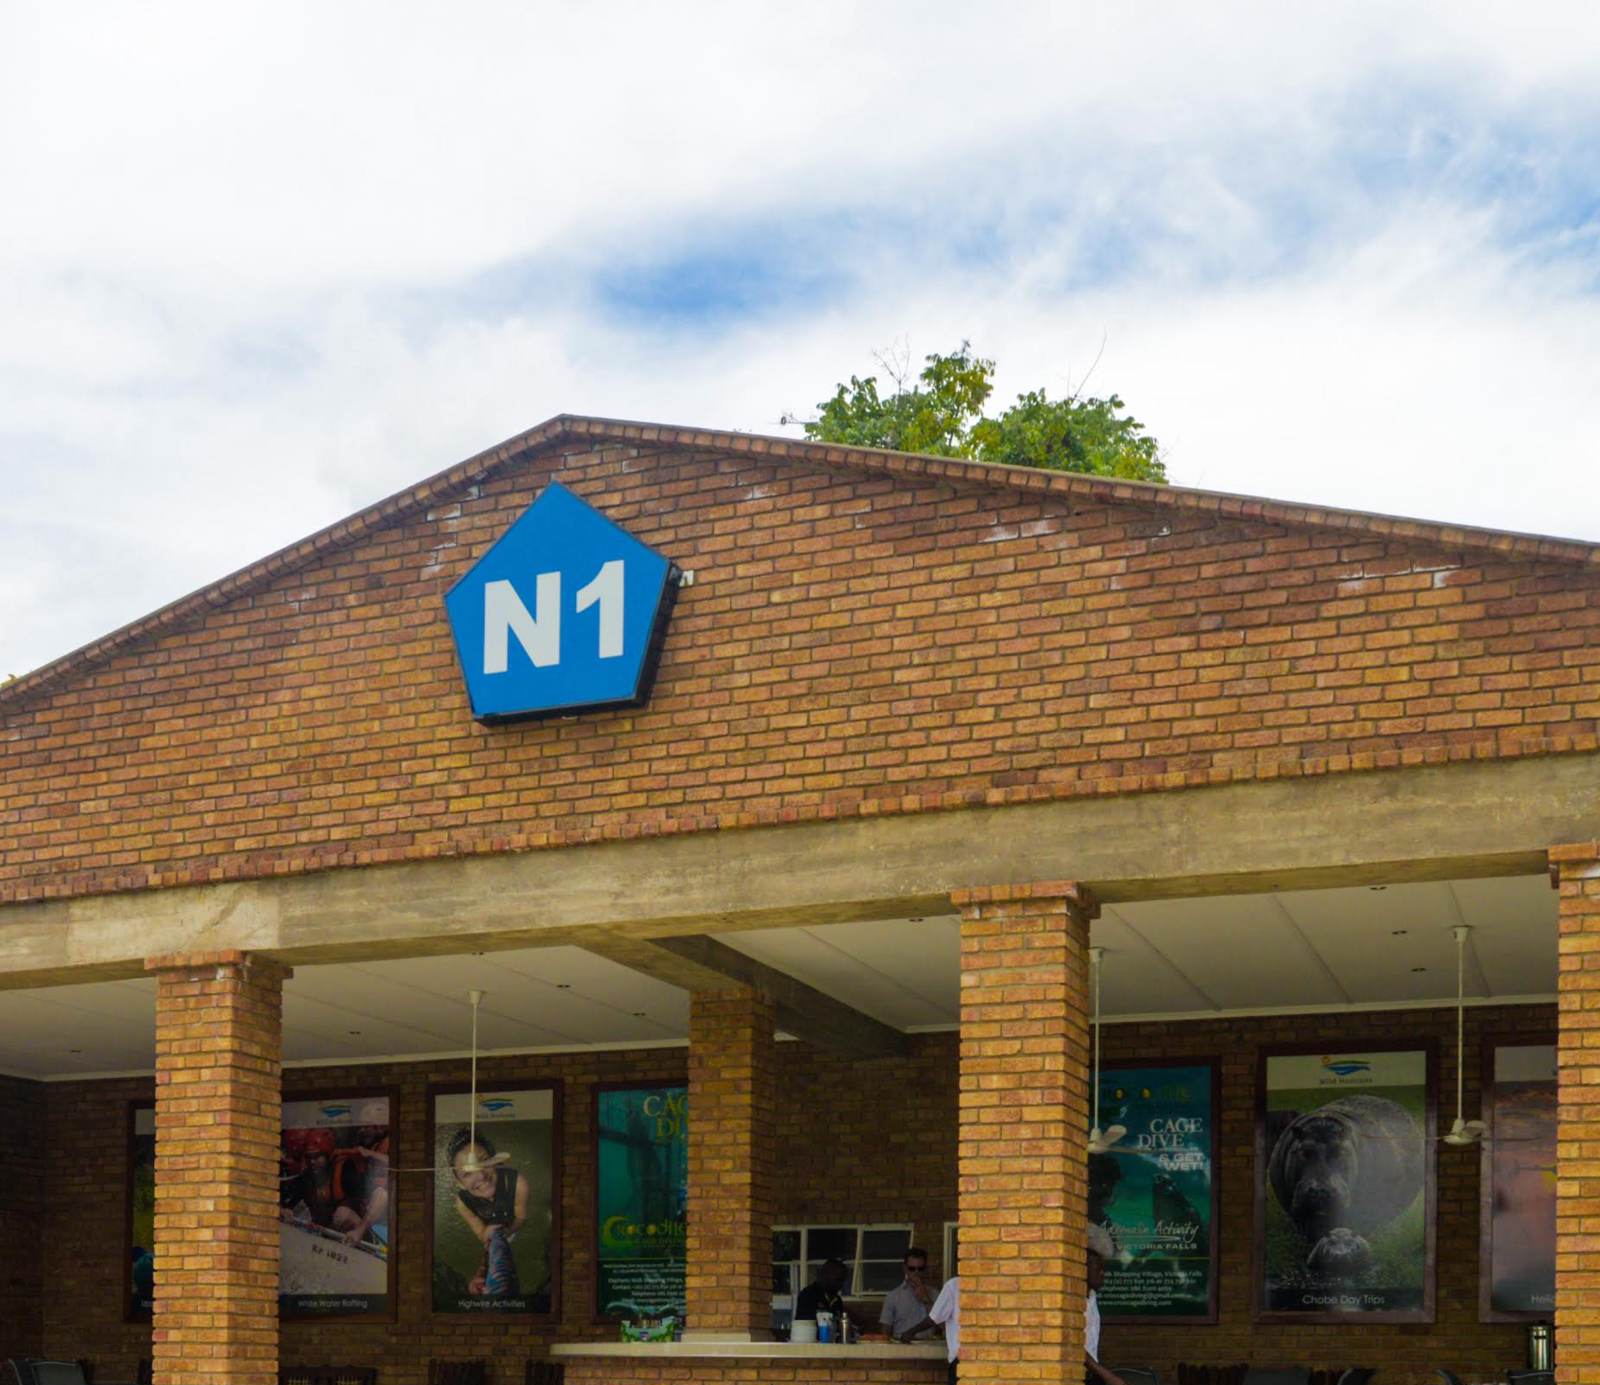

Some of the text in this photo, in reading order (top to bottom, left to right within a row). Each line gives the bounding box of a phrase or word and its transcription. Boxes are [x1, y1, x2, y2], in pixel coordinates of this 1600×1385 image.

[484, 560, 624, 674] N1
[1150, 1117, 1204, 1133] CAGE
[1138, 1133, 1185, 1149] DIVE
[1173, 1152, 1205, 1163] GET
[1154, 1219, 1200, 1243] Activity
[1165, 1242, 1198, 1250] FALLS
[1302, 1294, 1385, 1306] Chobe Day Trips
